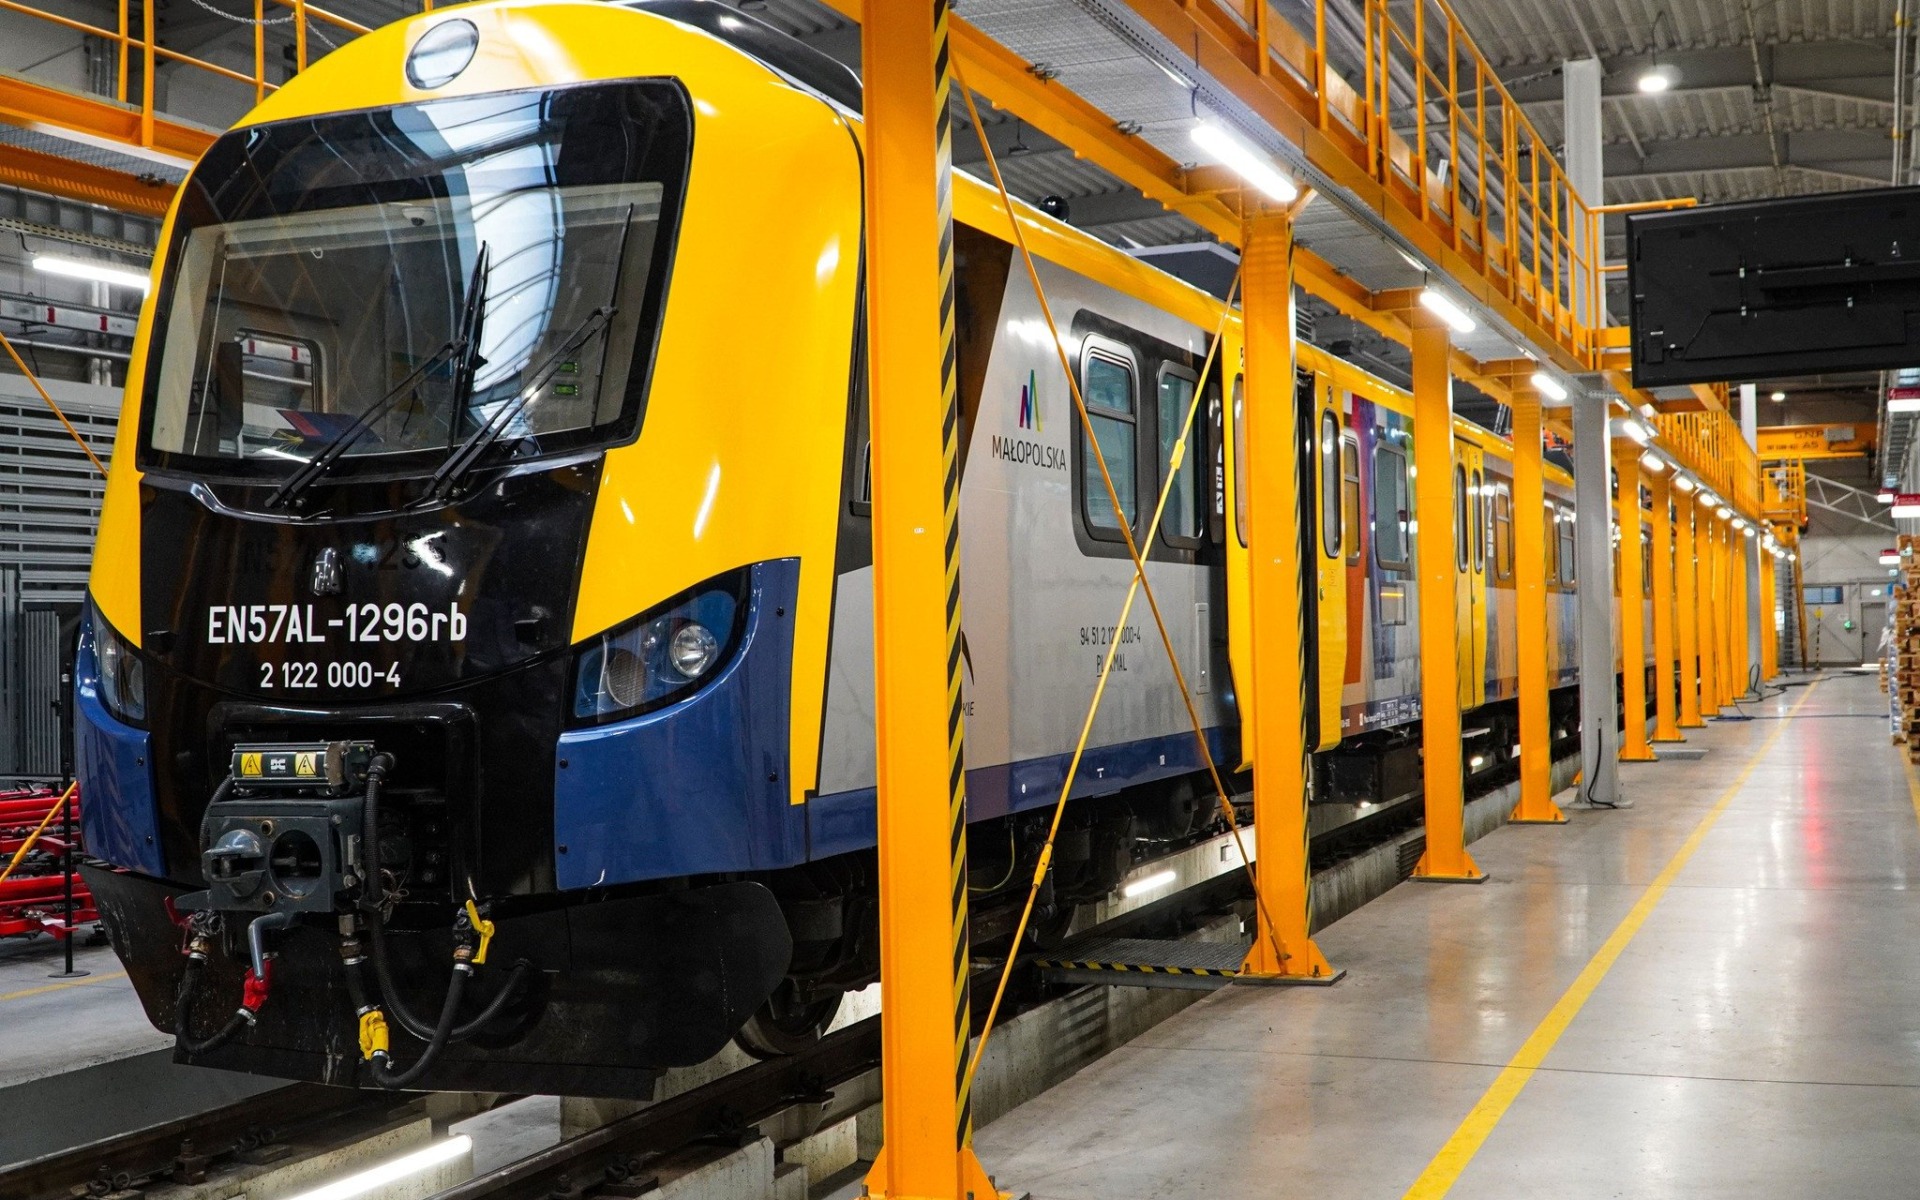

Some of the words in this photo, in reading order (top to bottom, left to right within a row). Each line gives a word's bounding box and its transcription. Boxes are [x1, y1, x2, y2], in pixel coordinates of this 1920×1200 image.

[992, 434, 1067, 471] MAŁOPOLSKA
[207, 601, 468, 644] EN57AL-1296rb
[1080, 627, 1089, 645] 94
[1092, 626, 1099, 645] 51
[1101, 626, 1106, 645] 2
[260, 662, 273, 688] 2
[281, 662, 318, 688] 122
[327, 661, 401, 688] 000-4
